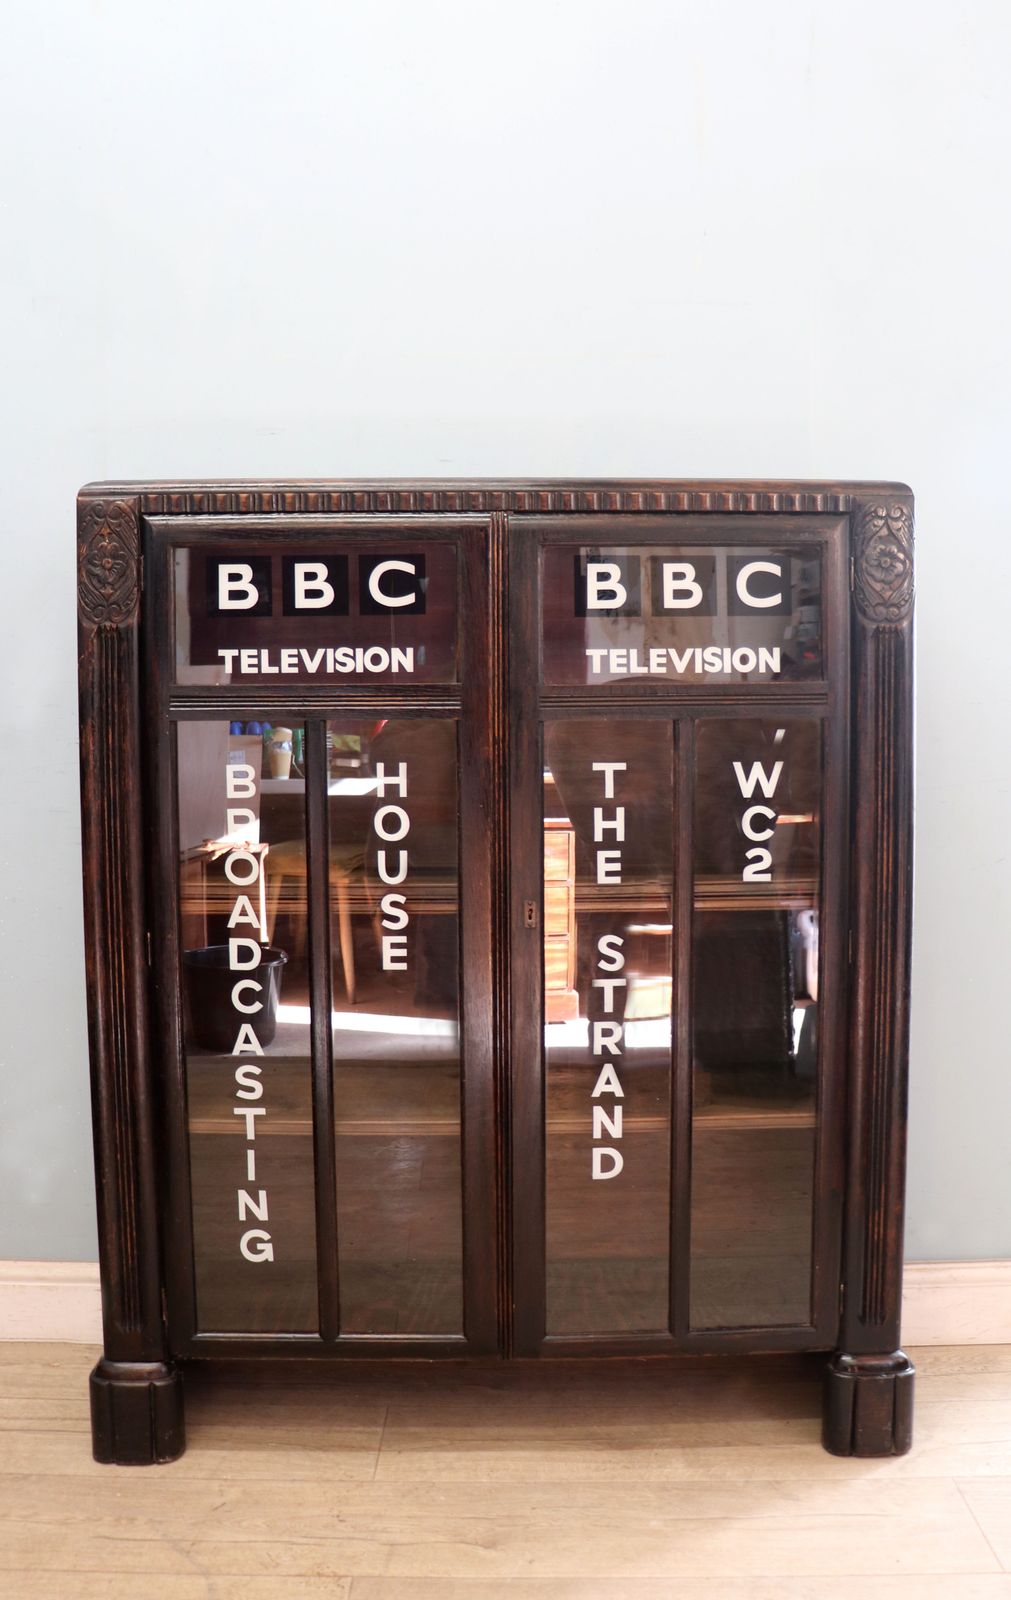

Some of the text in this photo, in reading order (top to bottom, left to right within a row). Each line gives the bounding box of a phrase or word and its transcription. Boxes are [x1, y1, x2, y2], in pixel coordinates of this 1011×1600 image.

[218, 560, 416, 610] BBC
[586, 561, 782, 609] BBC
[218, 647, 414, 674] TELEVISION
[586, 647, 781, 674] TELEVISION
[732, 761, 784, 882] WC2
[374, 762, 410, 971] HOUSE
[591, 762, 627, 1180] THE STRAND
